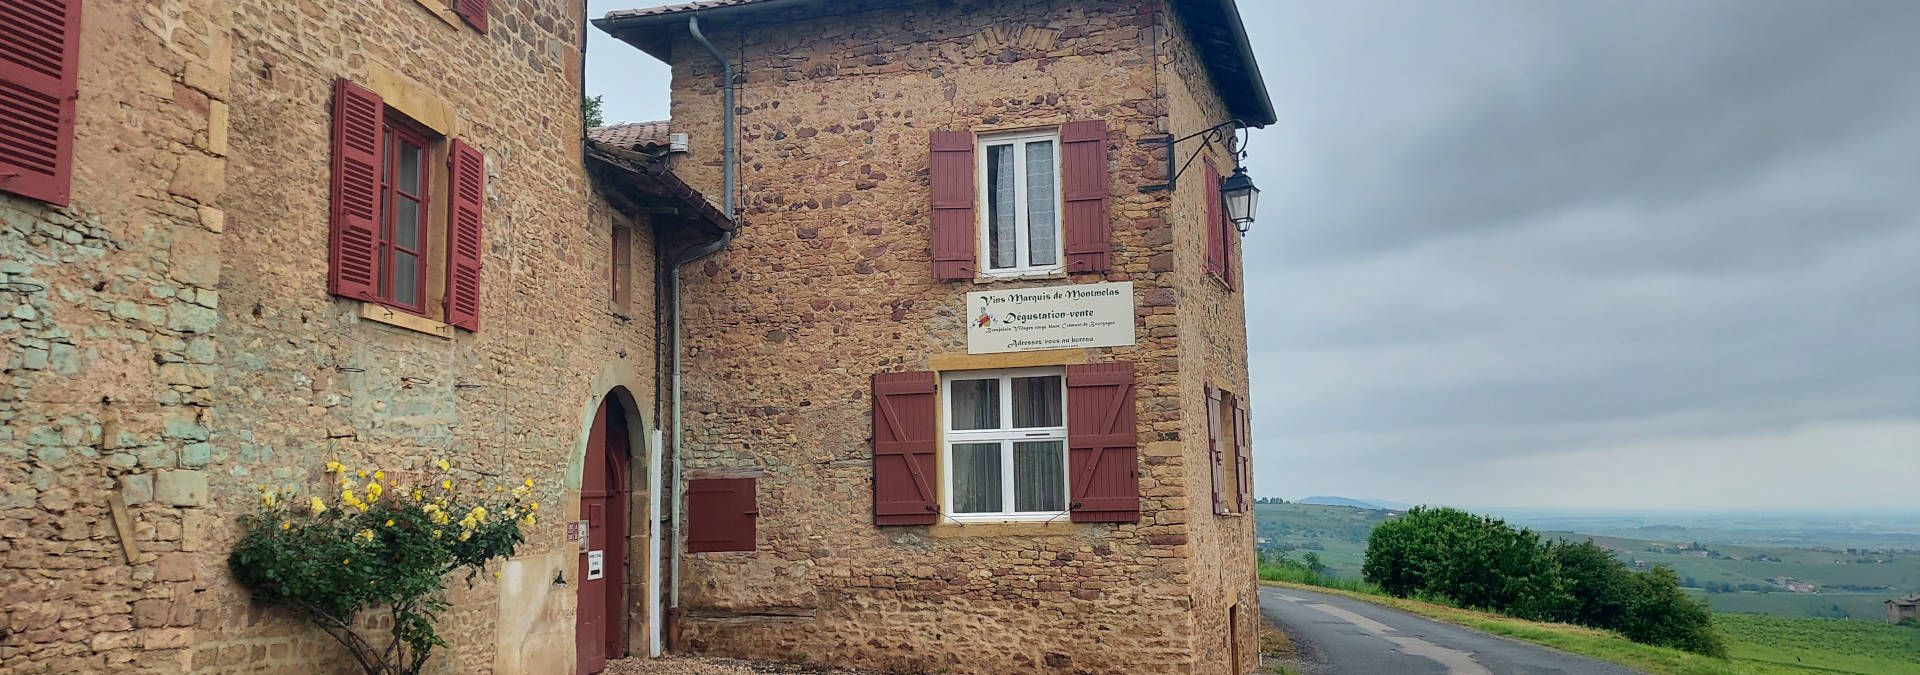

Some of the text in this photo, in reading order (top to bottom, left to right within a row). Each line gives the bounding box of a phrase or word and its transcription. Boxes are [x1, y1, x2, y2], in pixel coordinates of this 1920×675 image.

[980, 287, 1120, 306] Vins Marquis de Montmelas
[1003, 309, 1094, 324] Dégustation-vente
